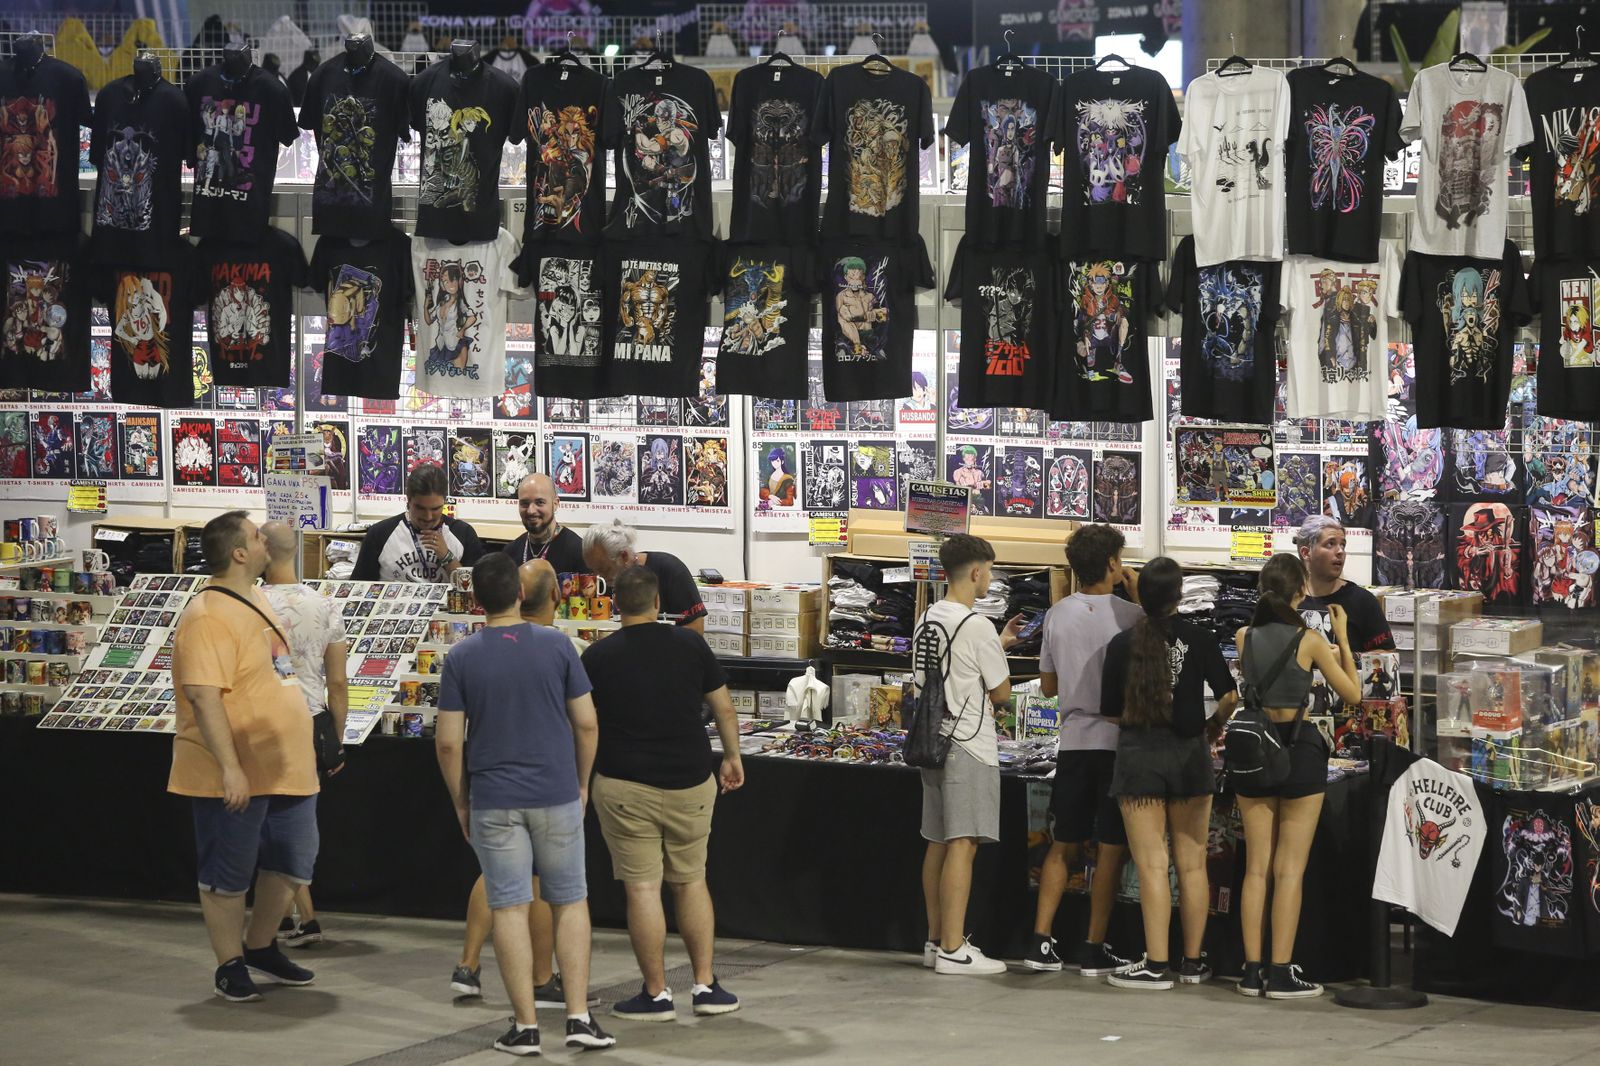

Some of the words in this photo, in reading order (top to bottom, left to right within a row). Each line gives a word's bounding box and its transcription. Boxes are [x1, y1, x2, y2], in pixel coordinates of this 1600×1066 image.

[514, 203, 527, 213] S2
[133, 319, 147, 331] 76
[613, 343, 632, 360] MI
[634, 343, 672, 362] PANA
[30, 412, 40, 421] 10
[74, 413, 83, 422] 15
[117, 413, 127, 421] 20
[126, 417, 157, 426] HAINSAW
[171, 419, 181, 427] 25
[216, 420, 225, 429] 30
[261, 421, 269, 430] 35
[305, 421, 314, 430] 40
[357, 426, 367, 435] 45
[403, 428, 412, 436] 50
[448, 429, 457, 437] 55
[494, 430, 503, 438] 60
[695, 428, 731, 436] CAMISETAS
[544, 436, 554, 444] 65
[590, 436, 600, 445] 70
[637, 437, 647, 446] 75
[683, 438, 693, 447] 80
[752, 442, 763, 450] 85
[800, 442, 810, 450] 90
[848, 442, 858, 450] 95
[996, 447, 1006, 456] 110
[1044, 450, 1054, 458] 115
[1093, 450, 1103, 460] 120
[267, 478, 287, 487] GANA
[302, 477, 319, 489] PS5
[911, 485, 968, 497] CAMISETAS
[1252, 490, 1275, 498] SHINY
[696, 508, 732, 516] CAMISETAS
[1167, 525, 1204, 533] CAMISETAS
[411, 567, 437, 579] CLUB
[1027, 709, 1041, 718] Pack
[1026, 717, 1055, 728] SORPRESA
[1423, 797, 1453, 819] CLUB
